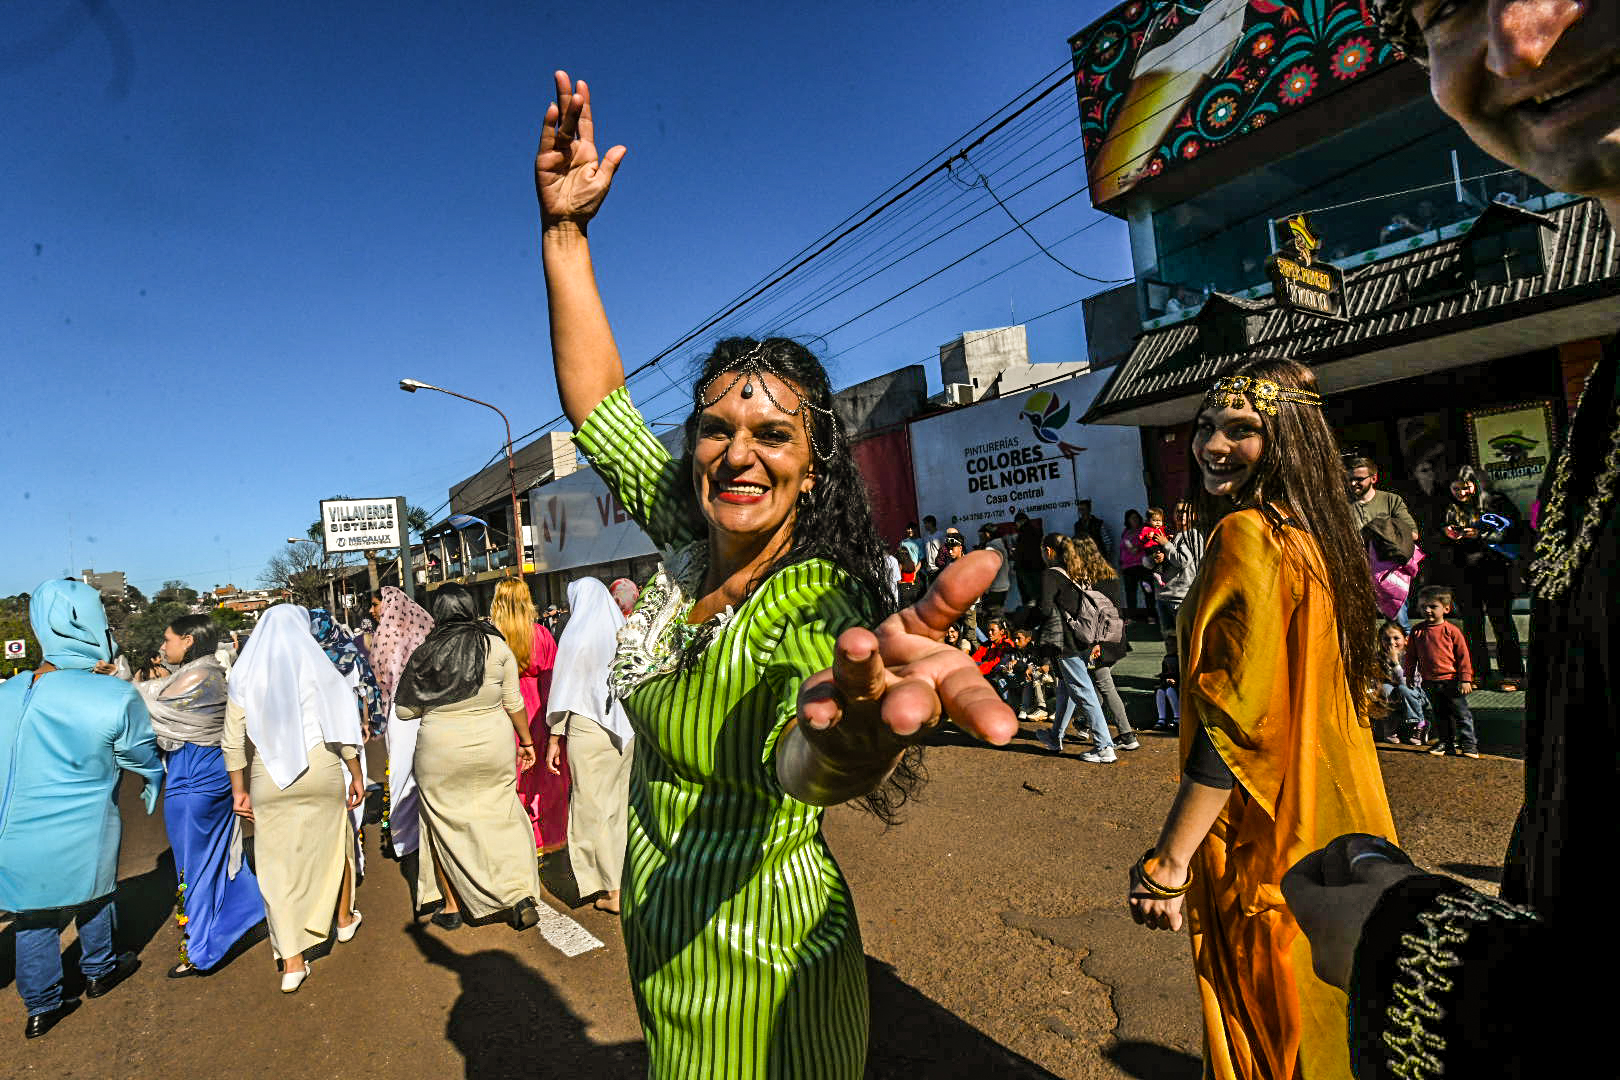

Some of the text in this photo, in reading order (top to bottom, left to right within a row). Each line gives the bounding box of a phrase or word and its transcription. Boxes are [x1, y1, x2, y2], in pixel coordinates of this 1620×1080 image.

[966, 444, 1043, 475] COLORES
[968, 461, 1061, 494] DEL NORTE
[986, 487, 1044, 505] Casa Central
[328, 504, 393, 522] VILLAVERDE
[330, 520, 394, 532] SISTEMAS
[348, 534, 391, 543] MECALUX
